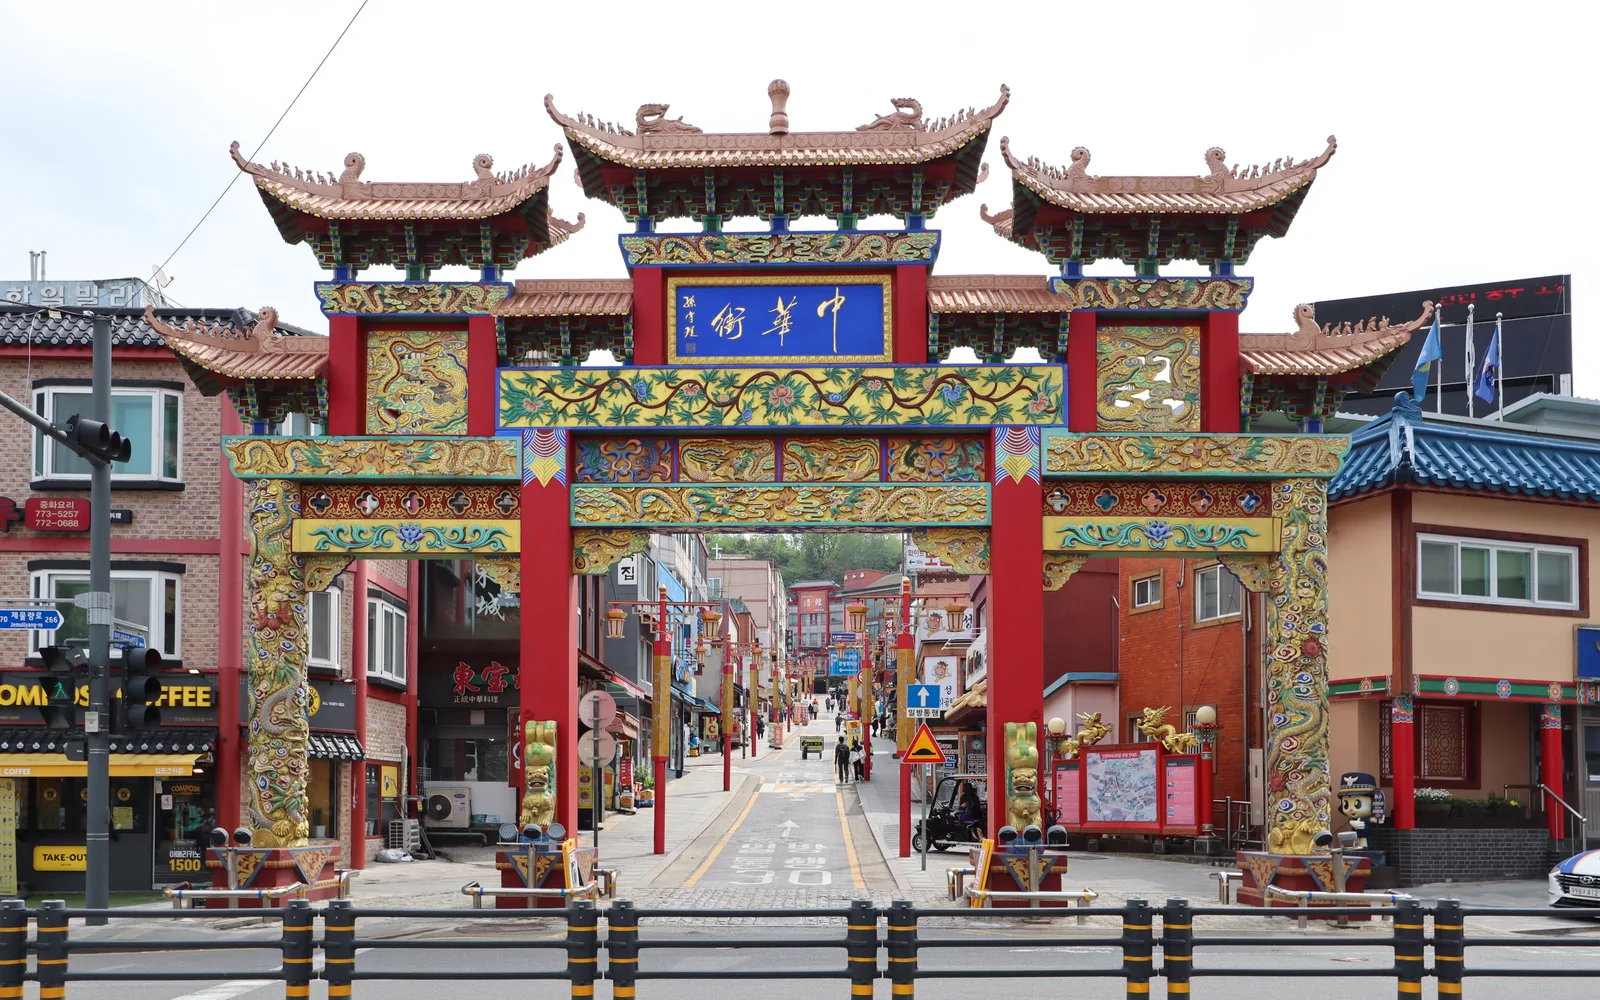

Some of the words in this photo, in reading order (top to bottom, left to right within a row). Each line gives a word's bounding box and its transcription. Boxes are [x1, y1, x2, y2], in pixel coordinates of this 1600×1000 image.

[40, 501, 74, 509] 중화요리
[35, 510, 79, 518] 773-5257
[35, 519, 79, 527] 772-0688
[11, 611, 43, 620] 제물량로
[453, 661, 520, 695] 東宝
[908, 709, 939, 717] 일방통행
[169, 859, 201, 871] 1500
[729, 870, 832, 885] 30
